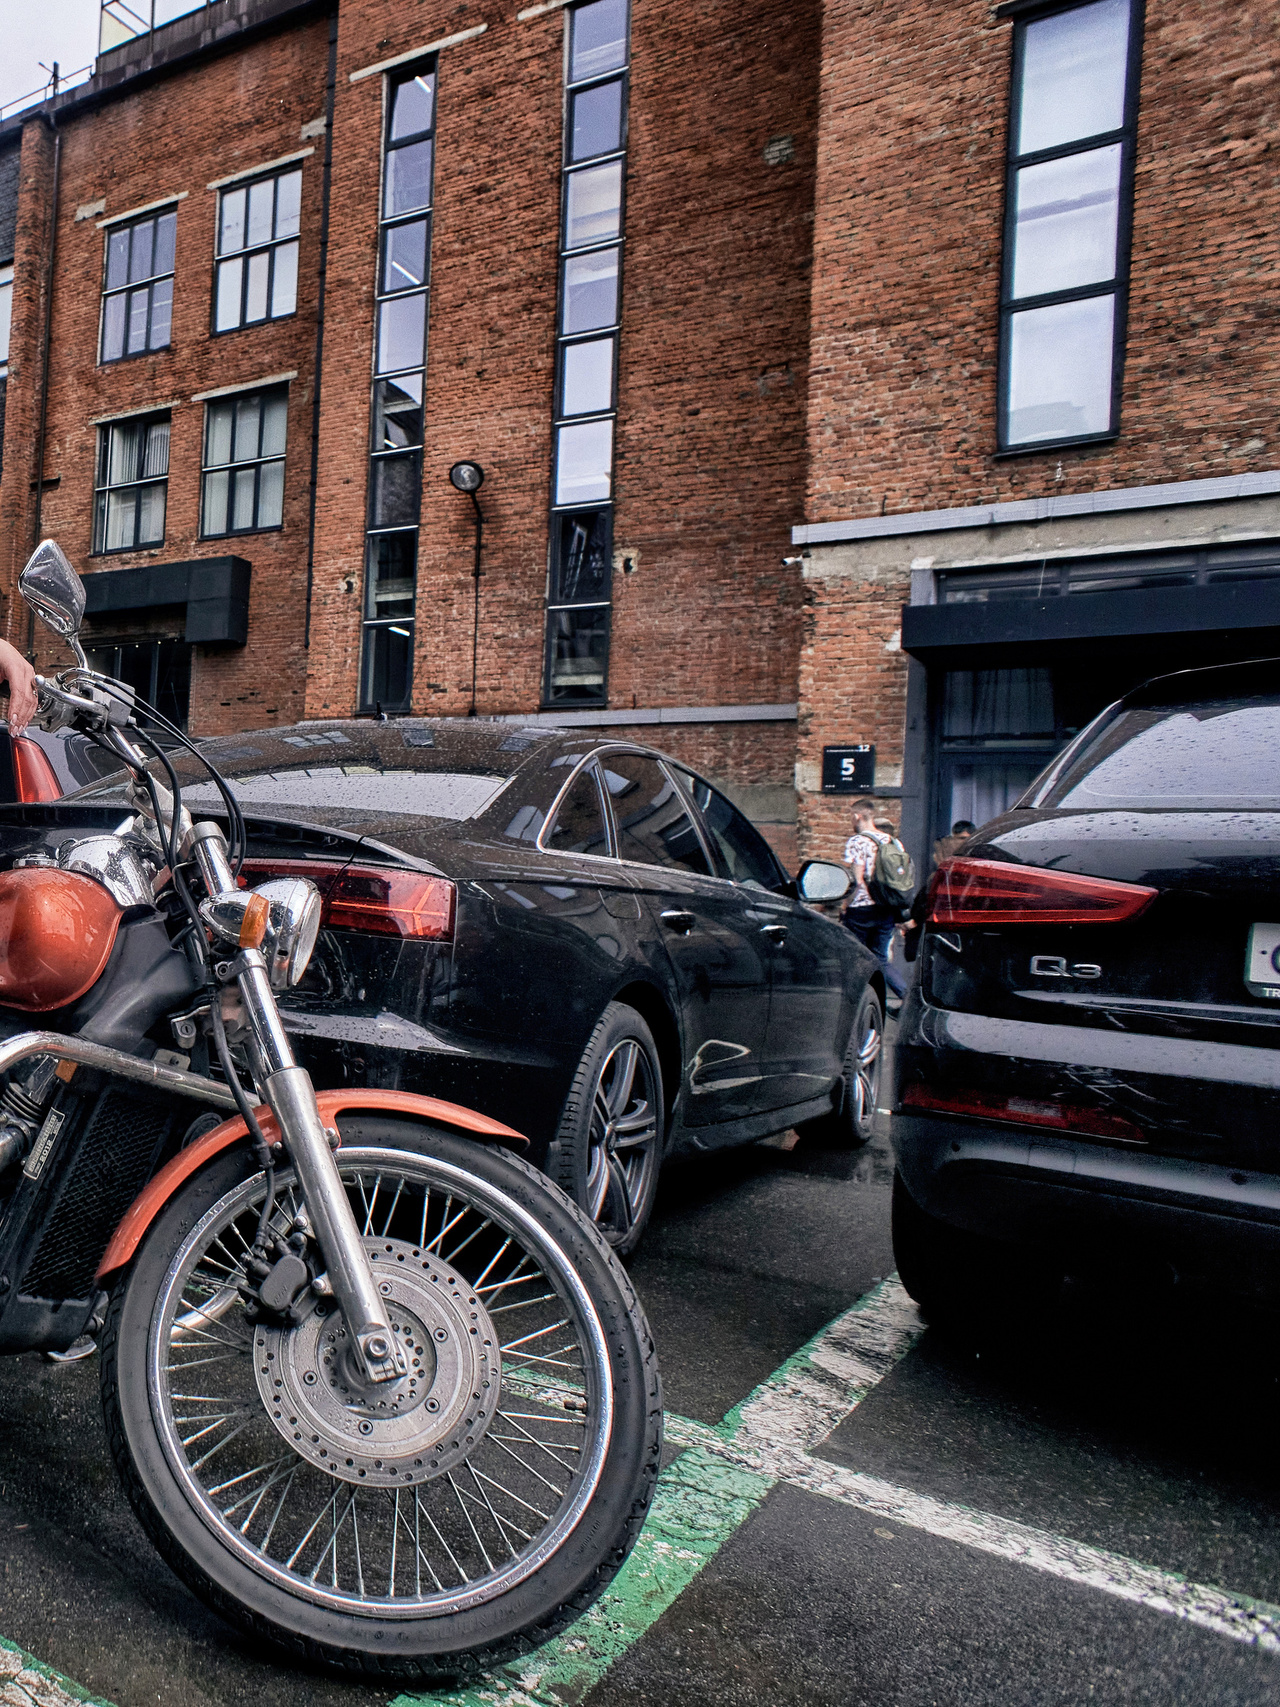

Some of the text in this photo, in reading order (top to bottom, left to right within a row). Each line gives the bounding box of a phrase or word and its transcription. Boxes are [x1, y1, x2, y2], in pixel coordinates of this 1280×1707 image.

[858, 744, 870, 752] 12
[841, 758, 855, 776] 5
[1030, 955, 1102, 979] Q3
